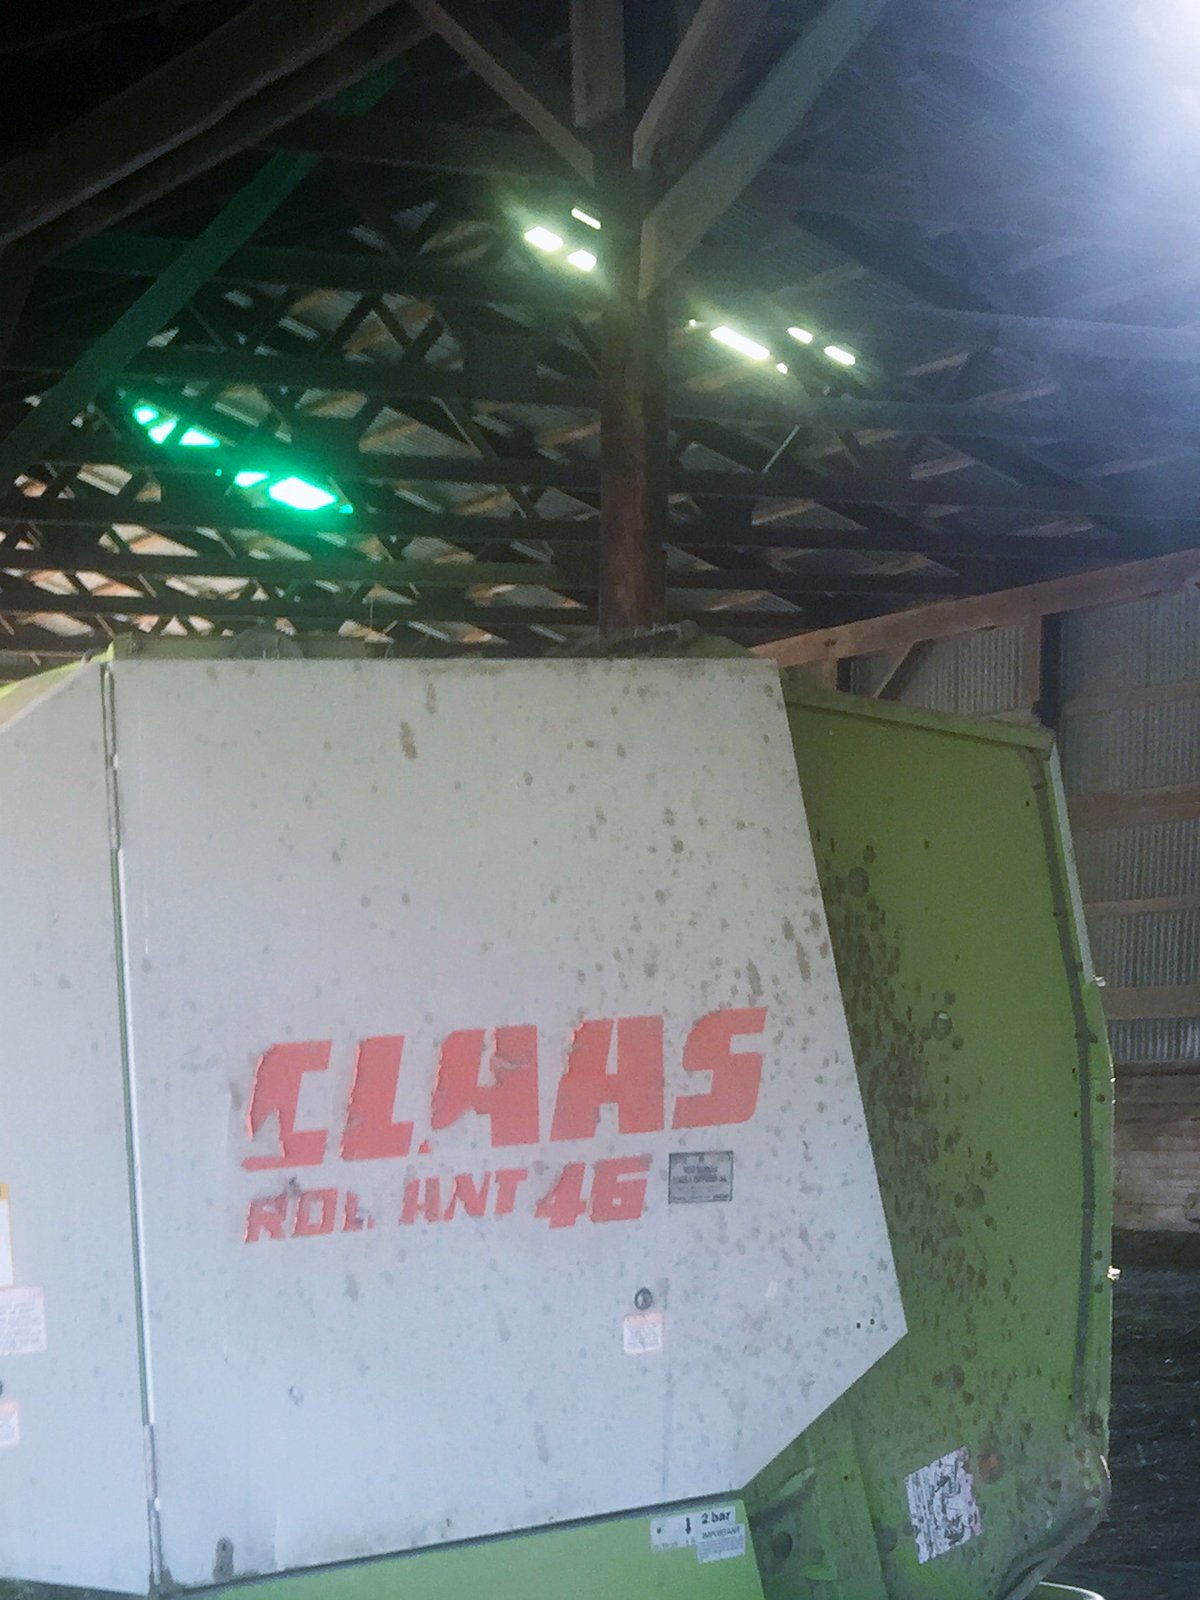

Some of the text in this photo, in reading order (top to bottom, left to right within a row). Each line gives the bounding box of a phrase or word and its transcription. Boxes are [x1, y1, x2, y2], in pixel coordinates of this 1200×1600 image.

[242, 1007, 767, 1171] CLAAS
[244, 1155, 650, 1243] ROLANT 46
[701, 1510, 731, 1524] 2 bar
